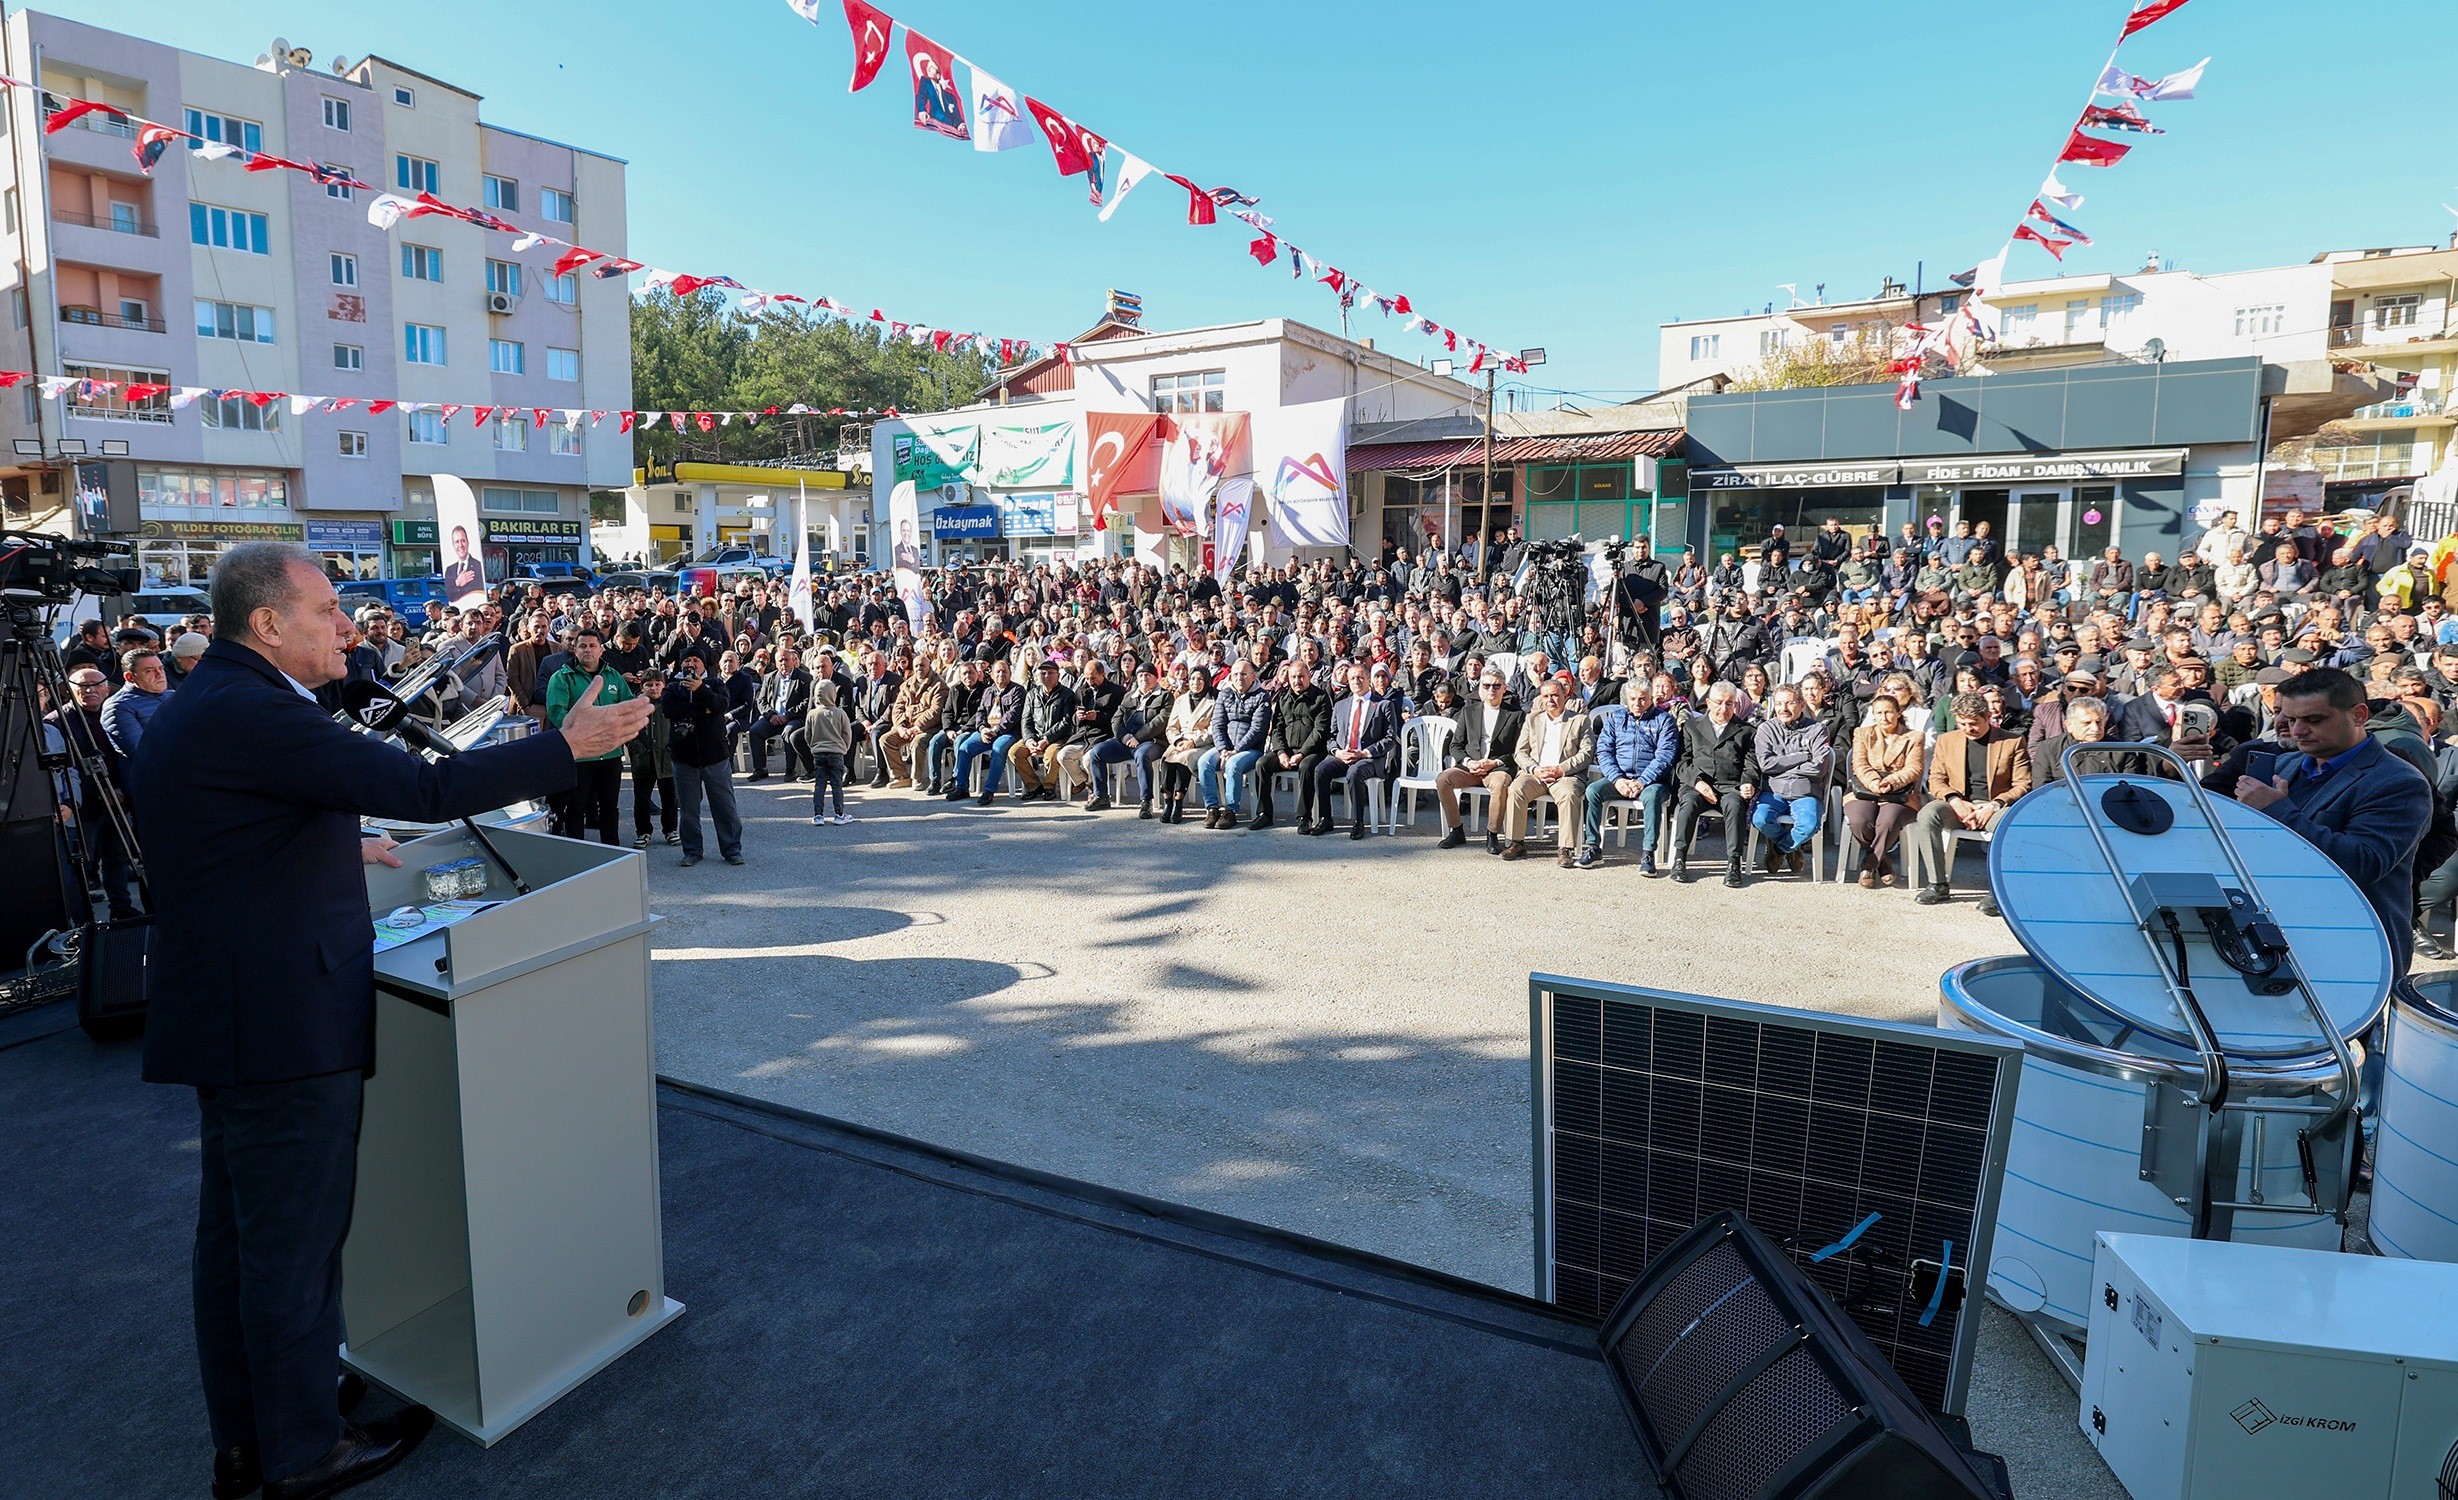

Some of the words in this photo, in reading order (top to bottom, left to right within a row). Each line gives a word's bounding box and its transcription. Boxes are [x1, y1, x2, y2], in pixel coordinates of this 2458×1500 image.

[914, 456, 931, 467] HOŞ
[1927, 465, 1960, 480] FİDE
[1973, 463, 2020, 478] FİDAN
[2033, 460, 2151, 478] DANIŞMANLIK
[1712, 472, 1760, 487] ZİRAİ
[1765, 470, 1880, 486] İLAÇ-GÜBRE
[171, 523, 209, 533] YILDIZ
[213, 524, 300, 536] FOTOĞRAFÇILIK
[490, 520, 559, 534] BAKIRLAR
[562, 523, 579, 534] ET
[936, 515, 993, 532] Özkaymak
[2306, 1417, 2357, 1432] KROM
